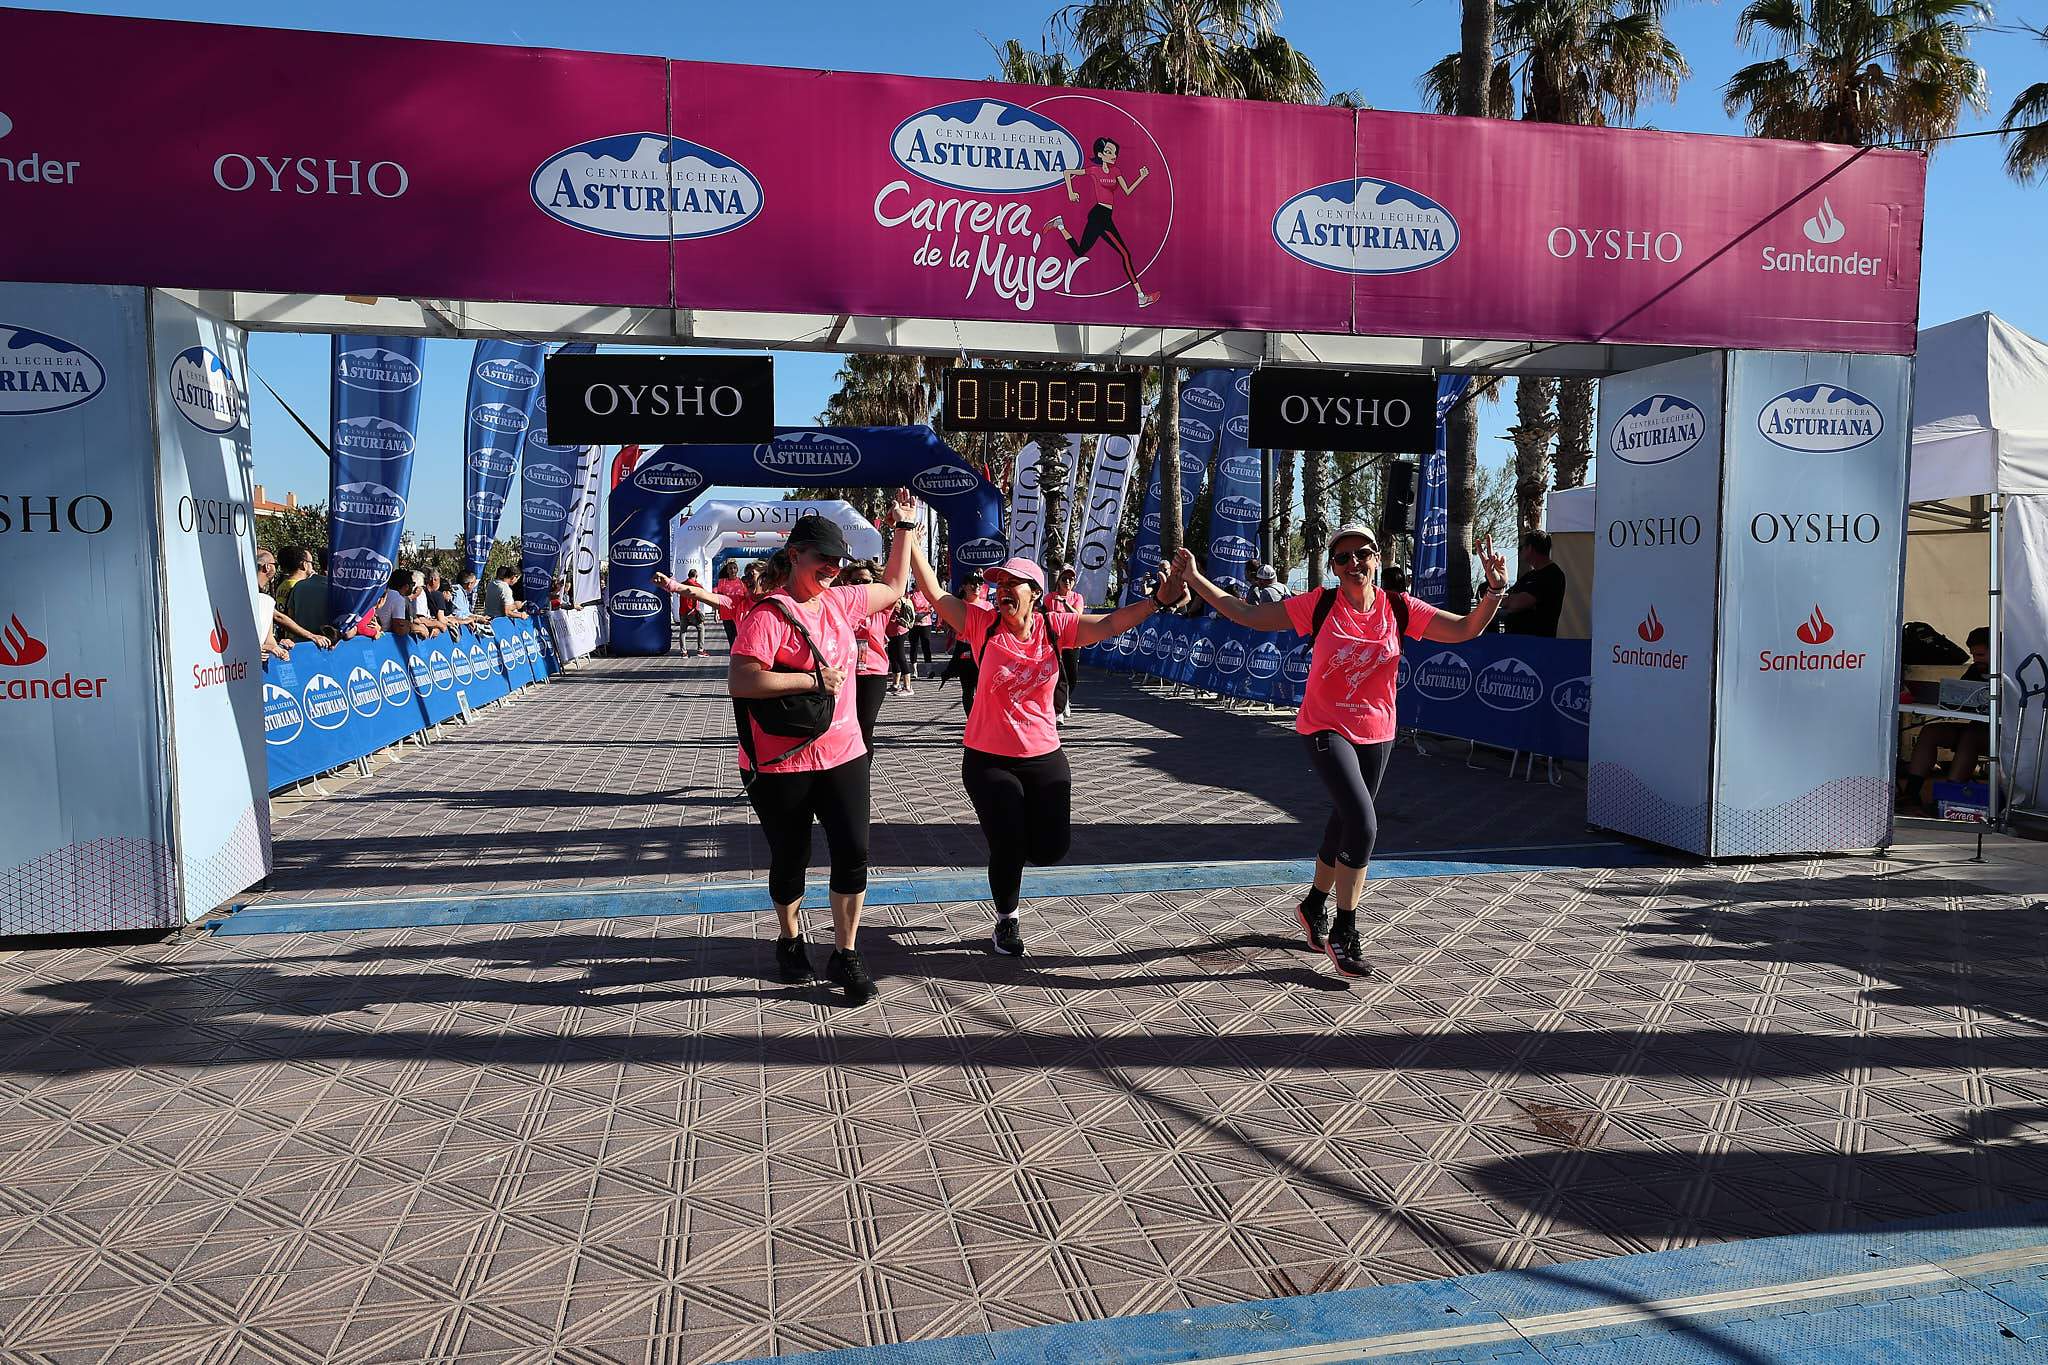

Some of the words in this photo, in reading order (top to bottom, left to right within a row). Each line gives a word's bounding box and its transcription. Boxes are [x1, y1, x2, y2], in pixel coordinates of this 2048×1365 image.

[906, 128, 1067, 172] ASTURIANA
[936, 128, 996, 141] CENTRAL
[1002, 132, 1063, 145] LECHERA
[213, 153, 409, 198] OYSHO
[586, 168, 658, 181] CENTRAL
[550, 168, 747, 215] ASTURIANA
[873, 180, 1033, 236] Carrera
[1316, 208, 1375, 221] CENTRAL
[1381, 212, 1440, 224] LECHERA
[1287, 209, 1446, 251] ASTURIANA
[1547, 226, 1684, 263] OYSHO
[913, 233, 943, 266] de
[950, 234, 970, 269] la
[965, 233, 1090, 311] Mujer
[1761, 246, 1882, 276] Santander
[338, 359, 413, 384] ASTURIANA
[176, 369, 238, 418] ASTURIANA
[584, 383, 743, 417] OYSHO
[957, 379, 1126, 422] 01:06:25
[1281, 395, 1411, 428] OYSHO
[1766, 408, 1875, 437] ASTURIANA
[1786, 407, 1827, 415] CENTRAL
[1829, 407, 1871, 416] LECHERA
[1616, 423, 1698, 452] ASTURIANA
[762, 445, 854, 466] ASTURIANA
[638, 473, 698, 486] ASTURIANA
[918, 477, 975, 489] ASTURIANA
[178, 495, 247, 536] OYSHO
[1014, 466, 1041, 559] YSHO
[1080, 434, 1132, 571] OYSHO
[1609, 514, 1701, 548] OYSHO
[1750, 512, 1881, 544] OYSHO
[612, 548, 659, 560] ASTURIANA
[960, 548, 1004, 560] ASTURIANA
[613, 598, 659, 611] ASTURIANA
[1612, 645, 1689, 670] Santander
[1759, 649, 1866, 671] Santander
[193, 661, 248, 689] Santander
[1416, 667, 1467, 690] ASTURIANA
[1479, 674, 1534, 701] ASTURIANA
[307, 698, 349, 719] ASTURIANA
